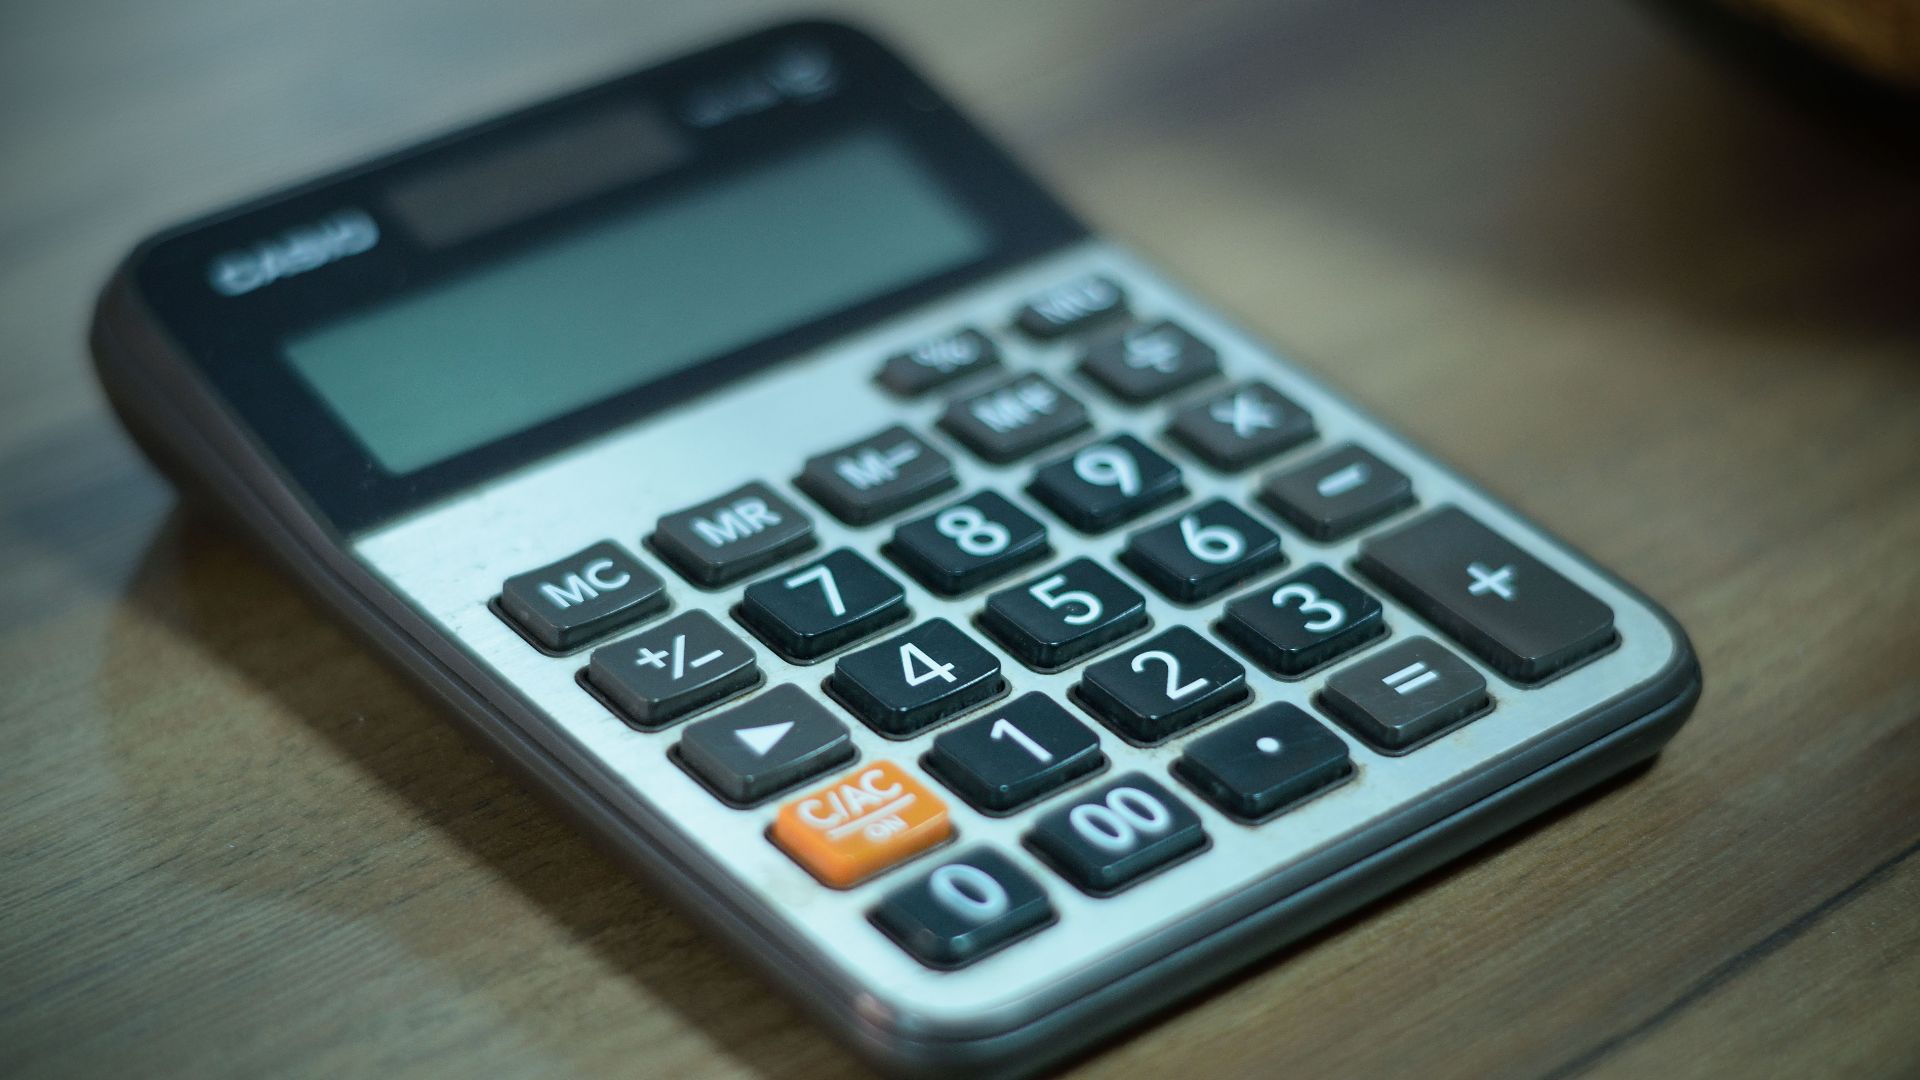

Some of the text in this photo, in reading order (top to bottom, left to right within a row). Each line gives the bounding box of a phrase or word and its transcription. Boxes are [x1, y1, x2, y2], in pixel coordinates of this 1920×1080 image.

[1073, 443, 1142, 497] 9
[690, 498, 784, 548] MR
[935, 505, 1011, 556] 8
[1179, 513, 1248, 563] 6
[539, 560, 632, 610] MC
[784, 564, 847, 616] 7
[1029, 574, 1103, 625] 5
[1271, 581, 1347, 633] 3
[899, 641, 958, 687] 4
[1130, 649, 1209, 700] 2
[989, 718, 1055, 763] 1
[797, 769, 902, 829] C/AC
[1069, 786, 1174, 851] 00
[864, 813, 911, 842] ON
[929, 863, 1011, 922] 0
